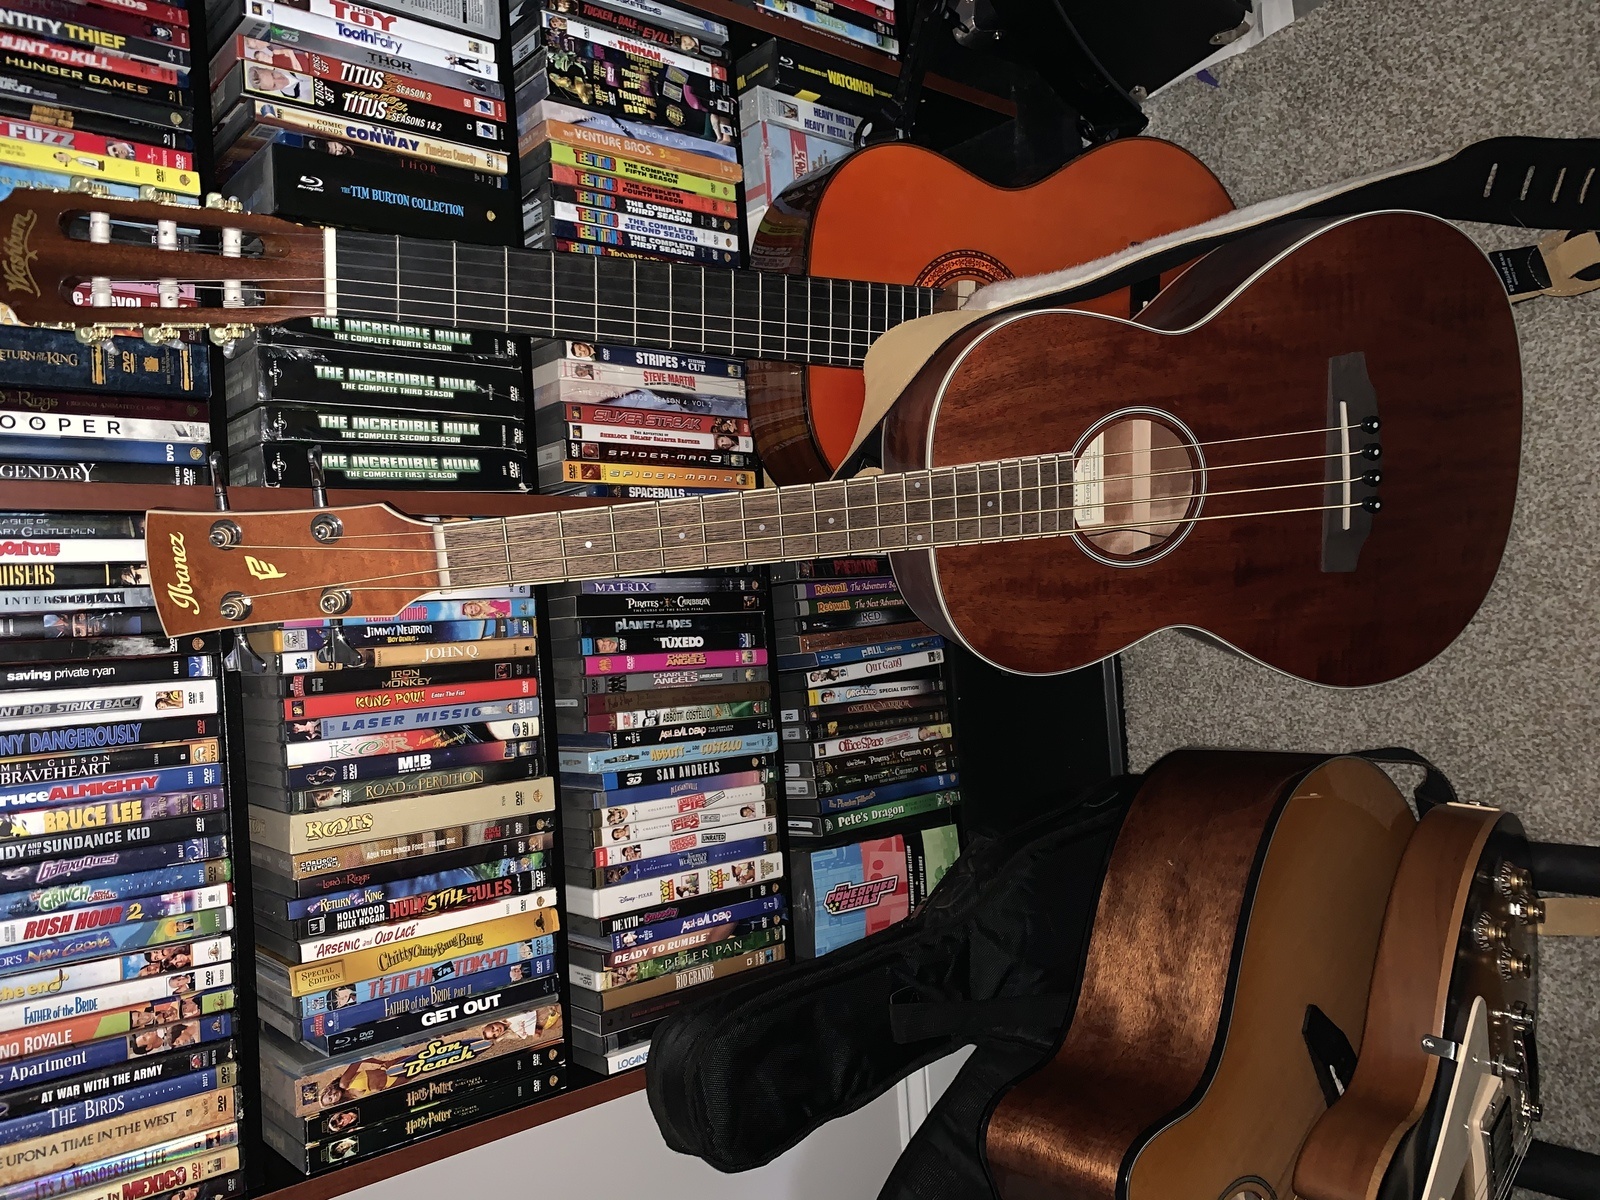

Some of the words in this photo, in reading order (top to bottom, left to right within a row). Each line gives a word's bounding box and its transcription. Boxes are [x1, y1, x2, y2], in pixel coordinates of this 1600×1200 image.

[330, 1, 397, 31] TOY
[349, 4, 375, 19] THE
[0, 10, 62, 34] NTITY
[65, 24, 126, 48] THIEF
[368, 52, 412, 71] THOR
[6, 56, 82, 79] HUNGER
[88, 74, 149, 94] GAMES
[340, 61, 385, 89] TITUS
[396, 84, 426, 101] SEASON
[425, 90, 432, 102] 3
[827, 70, 874, 97] WATCHMEN
[343, 93, 389, 119] TITUS
[392, 112, 424, 130] SEASONS
[813, 107, 834, 121] HEAVY
[835, 113, 856, 128] METAL
[9, 124, 74, 148] FUZZ
[307, 123, 343, 136] LEGENDS
[346, 125, 420, 151] CONWAY
[804, 118, 824, 134] HEAVY
[826, 125, 847, 140] METAL
[350, 185, 369, 199] TIM
[372, 189, 409, 206] BURTON
[411, 196, 464, 217] COLLECTION
[625, 199, 641, 208] THE
[643, 202, 693, 218] COMPLETE
[627, 206, 649, 216] THIRD
[652, 211, 692, 224] SEASON
[625, 223, 661, 235] SECOND
[664, 228, 698, 242] SEASON
[1, 208, 41, 298] Washburn
[631, 240, 653, 250] FIRST
[656, 244, 694, 257] SEASON
[636, 352, 680, 368] STRIPES
[688, 363, 706, 372] CUT
[315, 366, 343, 379] THE
[349, 369, 434, 387] INCREDIBLE
[439, 379, 477, 391] HULK
[643, 371, 666, 383] STEVE
[667, 373, 696, 387] MARTIN
[341, 382, 356, 390] THE
[358, 384, 398, 394] COMPLETE
[400, 388, 423, 397] THIRD
[425, 390, 454, 398] SEASON
[0, 415, 121, 435] OOPER
[318, 415, 348, 429] THE
[352, 417, 439, 433] INCREDIBLE
[443, 422, 480, 436] HULK
[593, 410, 643, 425] SILVER
[646, 414, 701, 429] STREAK
[357, 432, 397, 440] COMPLETE
[166, 443, 174, 462] DVD
[0, 463, 96, 482] GENDARY
[321, 455, 349, 468] THE
[352, 455, 437, 470] INCREDIBLE
[442, 458, 480, 471] HULK
[629, 487, 685, 498] SPACEBALLS
[167, 531, 200, 615] Ibanez
[594, 582, 651, 593] MATRIX
[814, 582, 848, 596] Redwall
[5, 593, 122, 605] INTERSTELLAR
[626, 596, 659, 609] PIRATES
[677, 595, 710, 607] CARIBBEAN
[861, 611, 882, 622] RED
[364, 626, 395, 638] JIMMY
[396, 624, 432, 636] NEUTRON
[666, 657, 706, 667] ANGELS
[865, 660, 881, 674] Our
[882, 658, 902, 669] Gang
[7, 669, 51, 681] saving
[54, 668, 89, 680] private
[92, 666, 116, 677] ryan
[381, 677, 431, 689] MONKEY
[391, 669, 420, 679] IRON
[653, 677, 698, 685] ANGELS
[1, 707, 20, 716] NT
[23, 704, 51, 713] BOB
[56, 700, 101, 712] STRIKE
[104, 696, 141, 708] BACK
[1, 734, 24, 755] NY
[30, 723, 142, 752] DANGEROUSLY
[838, 739, 861, 753] Office
[1, 762, 110, 784] BRAVEHEART
[656, 768, 677, 780] SAN
[679, 761, 720, 777] ANDREAS
[44, 807, 106, 832] BRUCE
[111, 800, 142, 825] LEE
[838, 810, 868, 827] Pete's
[871, 804, 904, 820] Dragon
[306, 813, 374, 840] ROOTS
[827, 880, 895, 903] POWERPUFF
[841, 893, 879, 909] GIRLS
[24, 915, 71, 939] RUSH
[74, 907, 123, 929] HOUR
[126, 903, 144, 920] 2
[337, 905, 385, 922] HOLLYWOOD
[337, 918, 358, 930] HULK
[360, 913, 385, 926] HOGAN
[612, 915, 640, 932] DEATH
[614, 946, 650, 964] READY
[652, 943, 665, 955] TO
[667, 932, 707, 951] RUMBLE
[664, 950, 709, 970] PETER
[714, 939, 743, 955] PAN
[301, 967, 334, 981] SPECIAL
[308, 973, 340, 987] EDITION
[675, 974, 688, 990] RIO
[689, 965, 715, 985] GRANDE
[385, 994, 409, 1016] FATHER
[411, 995, 418, 1009] of
[418, 994, 429, 1006] the
[430, 985, 451, 1004] BRIDE
[421, 1004, 460, 1027] GET
[463, 993, 501, 1014] OUT
[1, 1042, 22, 1056] NO
[24, 1029, 71, 1051] ROYALE
[10, 1051, 87, 1081] Apartment
[403, 1047, 475, 1078] Beach
[41, 1092, 54, 1104] AT
[56, 1085, 80, 1099] WAR
[83, 1078, 110, 1094] WITH
[112, 1074, 130, 1087] THE
[134, 1065, 163, 1082] ARMY
[406, 1087, 428, 1107] Harry
[427, 1080, 454, 1101] Potter
[48, 1108, 77, 1129] THE
[84, 1096, 125, 1119] BIRDS
[405, 1118, 427, 1136] Harry
[427, 1108, 453, 1131] Potter
[9, 1148, 46, 1169] UPON
[50, 1144, 59, 1156] A
[61, 1133, 94, 1152] TIME
[97, 1128, 113, 1142] IN
[115, 1121, 142, 1137] THE
[144, 1111, 176, 1129] WEST
